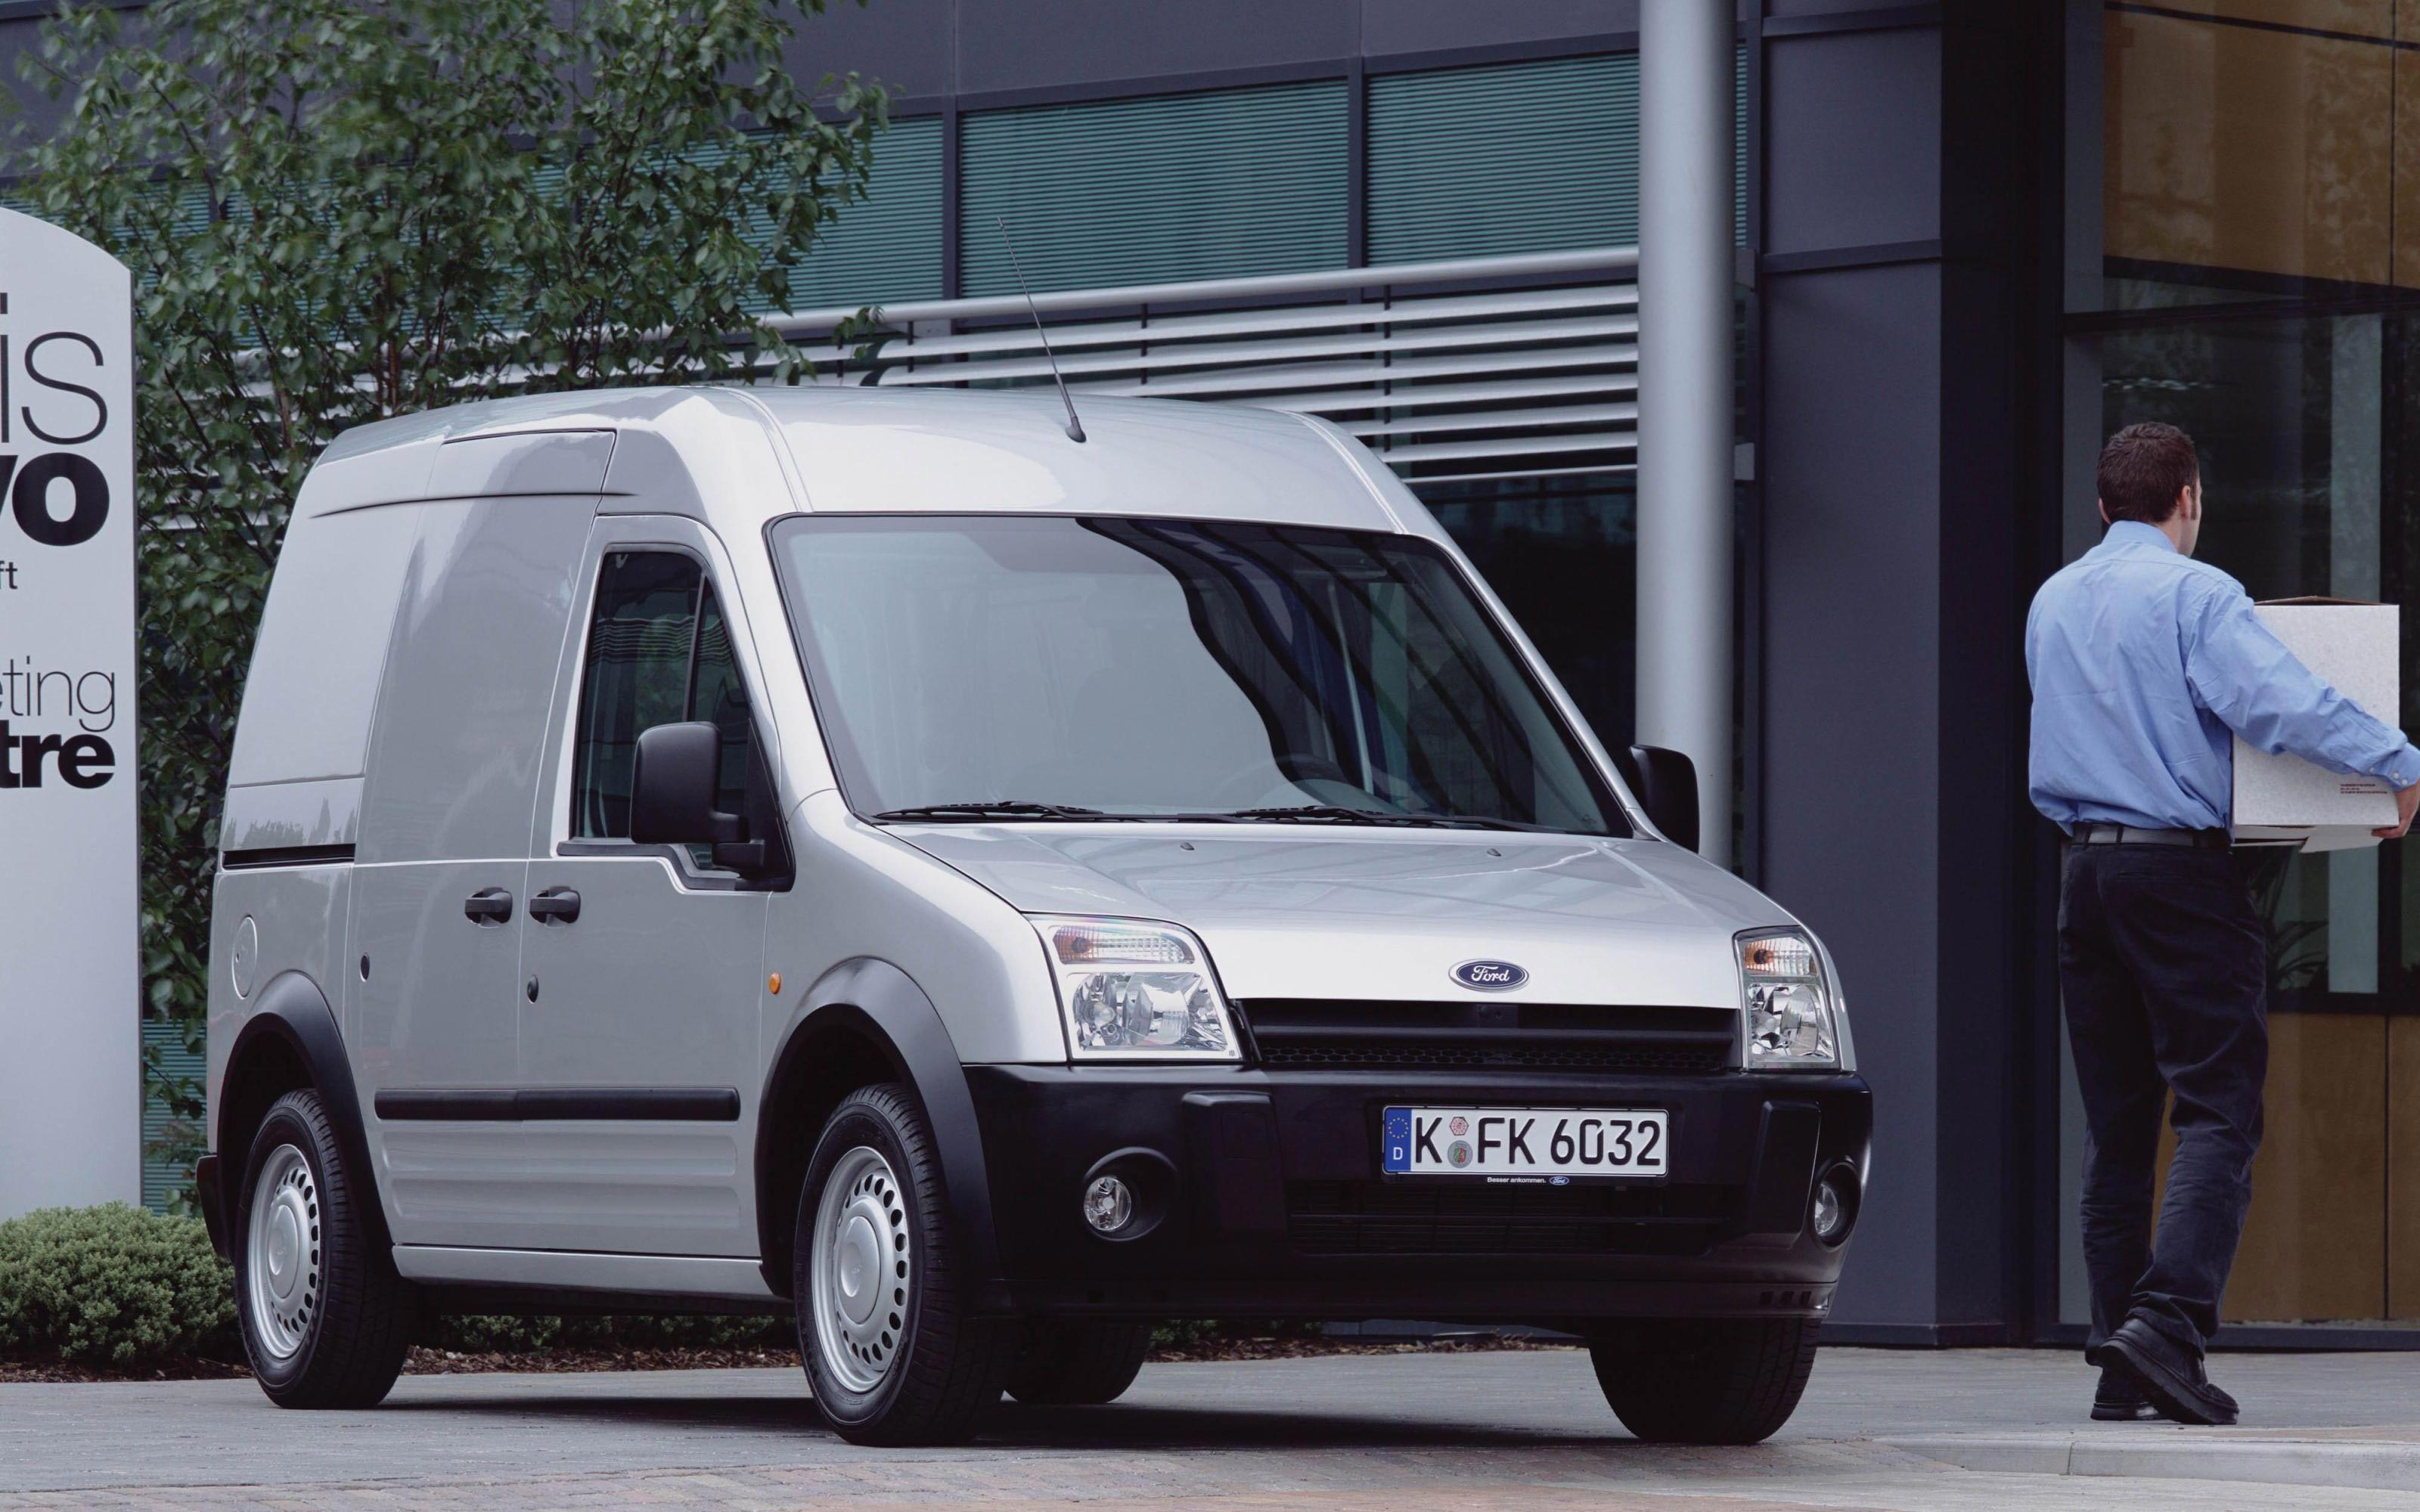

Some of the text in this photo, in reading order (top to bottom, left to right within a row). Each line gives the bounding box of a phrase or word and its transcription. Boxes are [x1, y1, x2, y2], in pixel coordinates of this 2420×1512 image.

[0, 655, 115, 733] ting
[1471, 965, 1510, 981] Ford
[1393, 1147, 1403, 1160] D
[1416, 1117, 1661, 1166] K FK 6032
